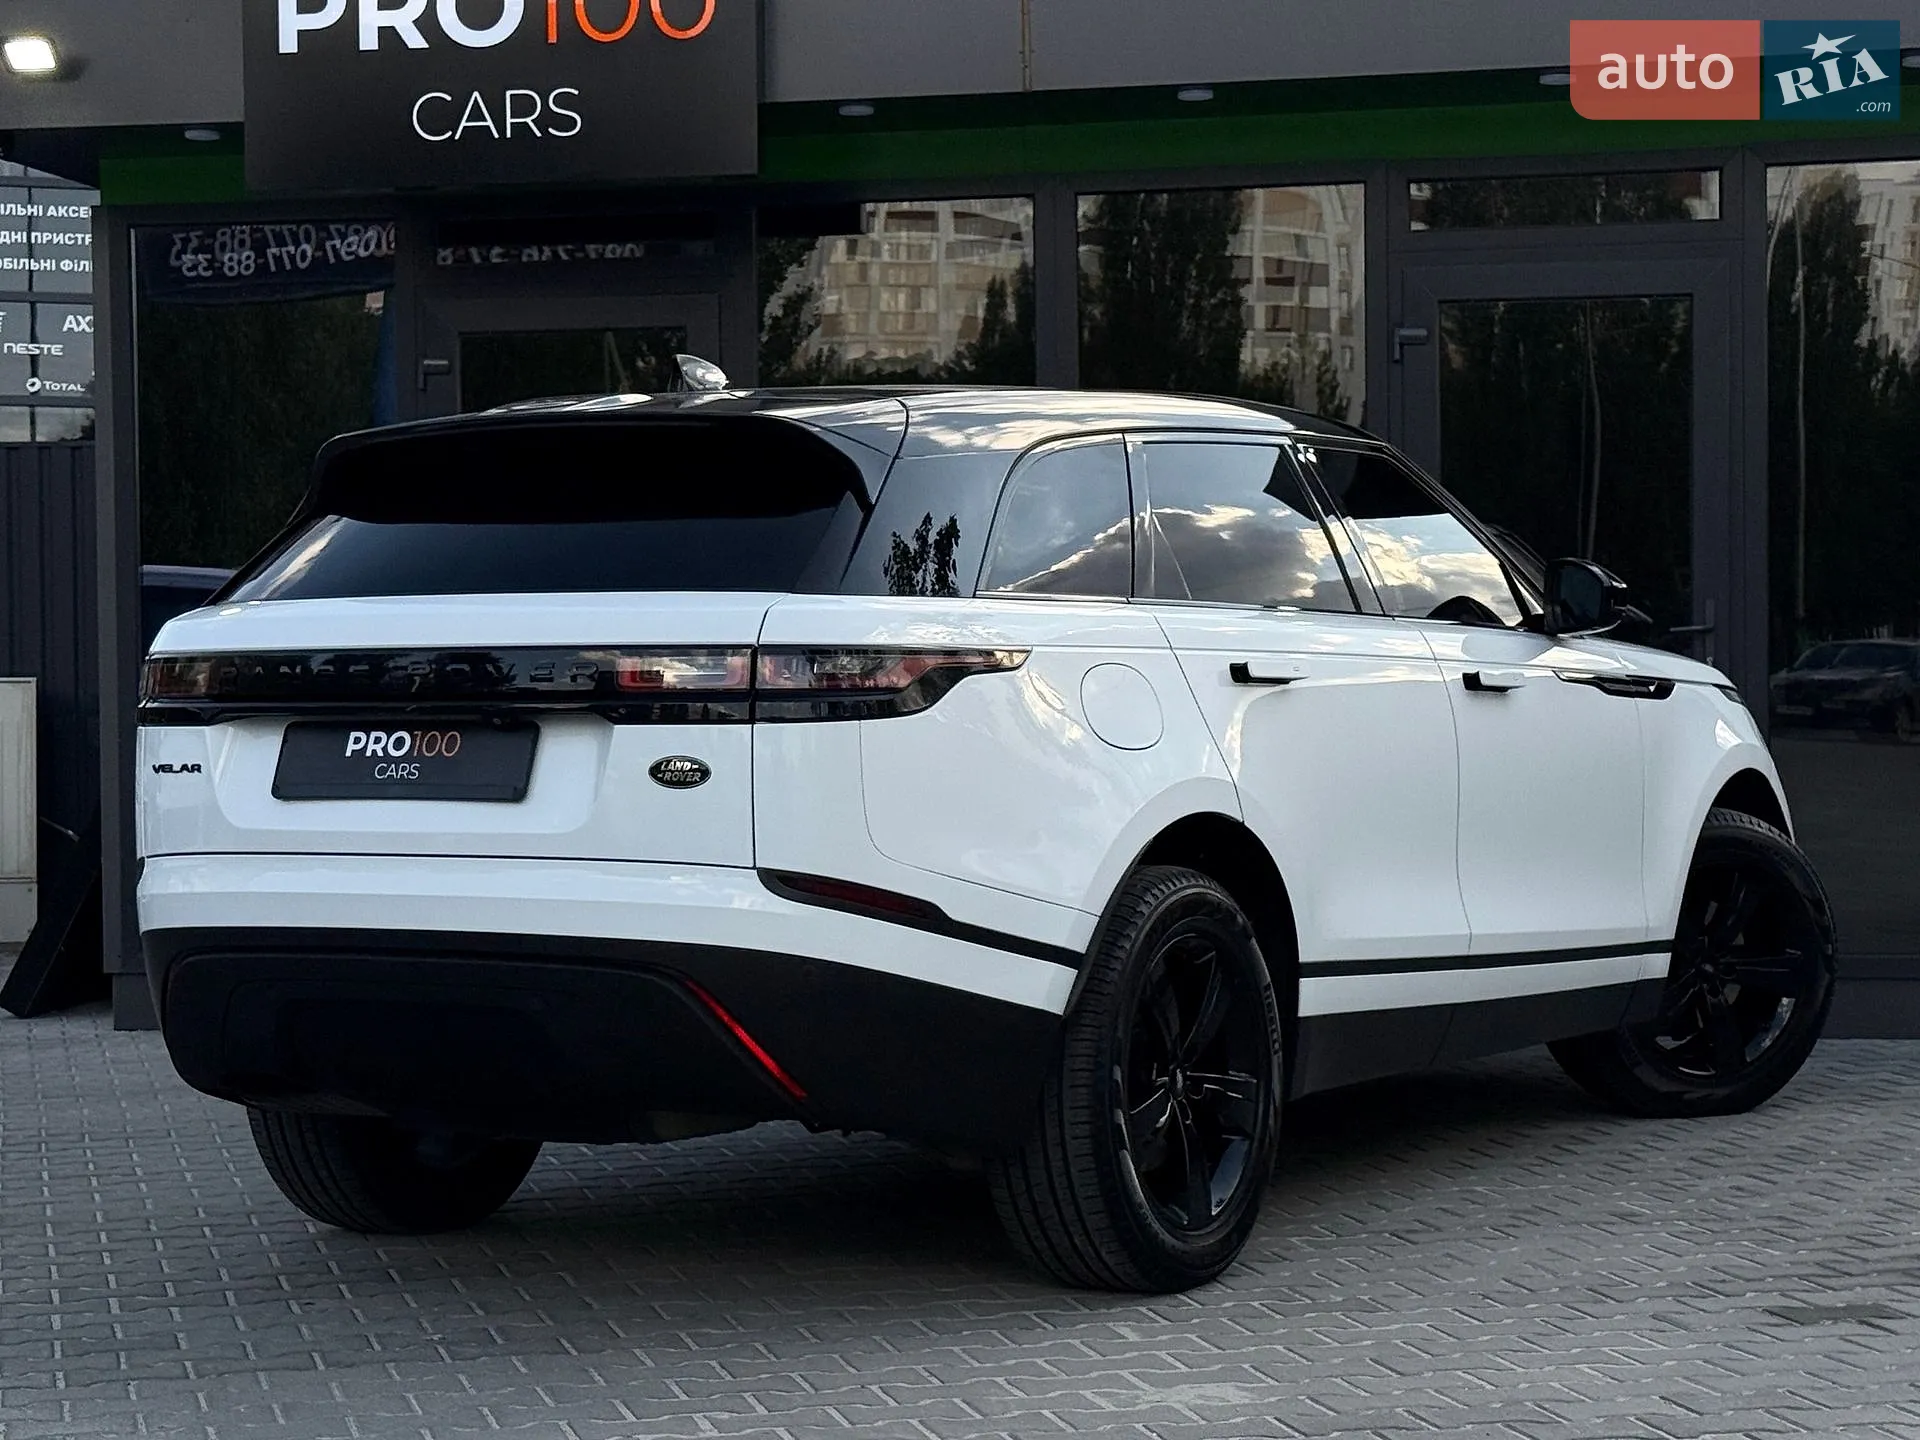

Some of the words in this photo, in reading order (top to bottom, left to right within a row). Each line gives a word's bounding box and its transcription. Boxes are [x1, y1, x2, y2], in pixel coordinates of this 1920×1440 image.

[411, 87, 582, 141] CARS
[46, 205, 92, 218] АКСЕ
[0, 257, 56, 271] БІЛЬНІ
[43, 380, 86, 392] TOTAL
[345, 731, 461, 757] PRO100
[151, 763, 202, 774] VELAR
[374, 763, 421, 779] CARS
